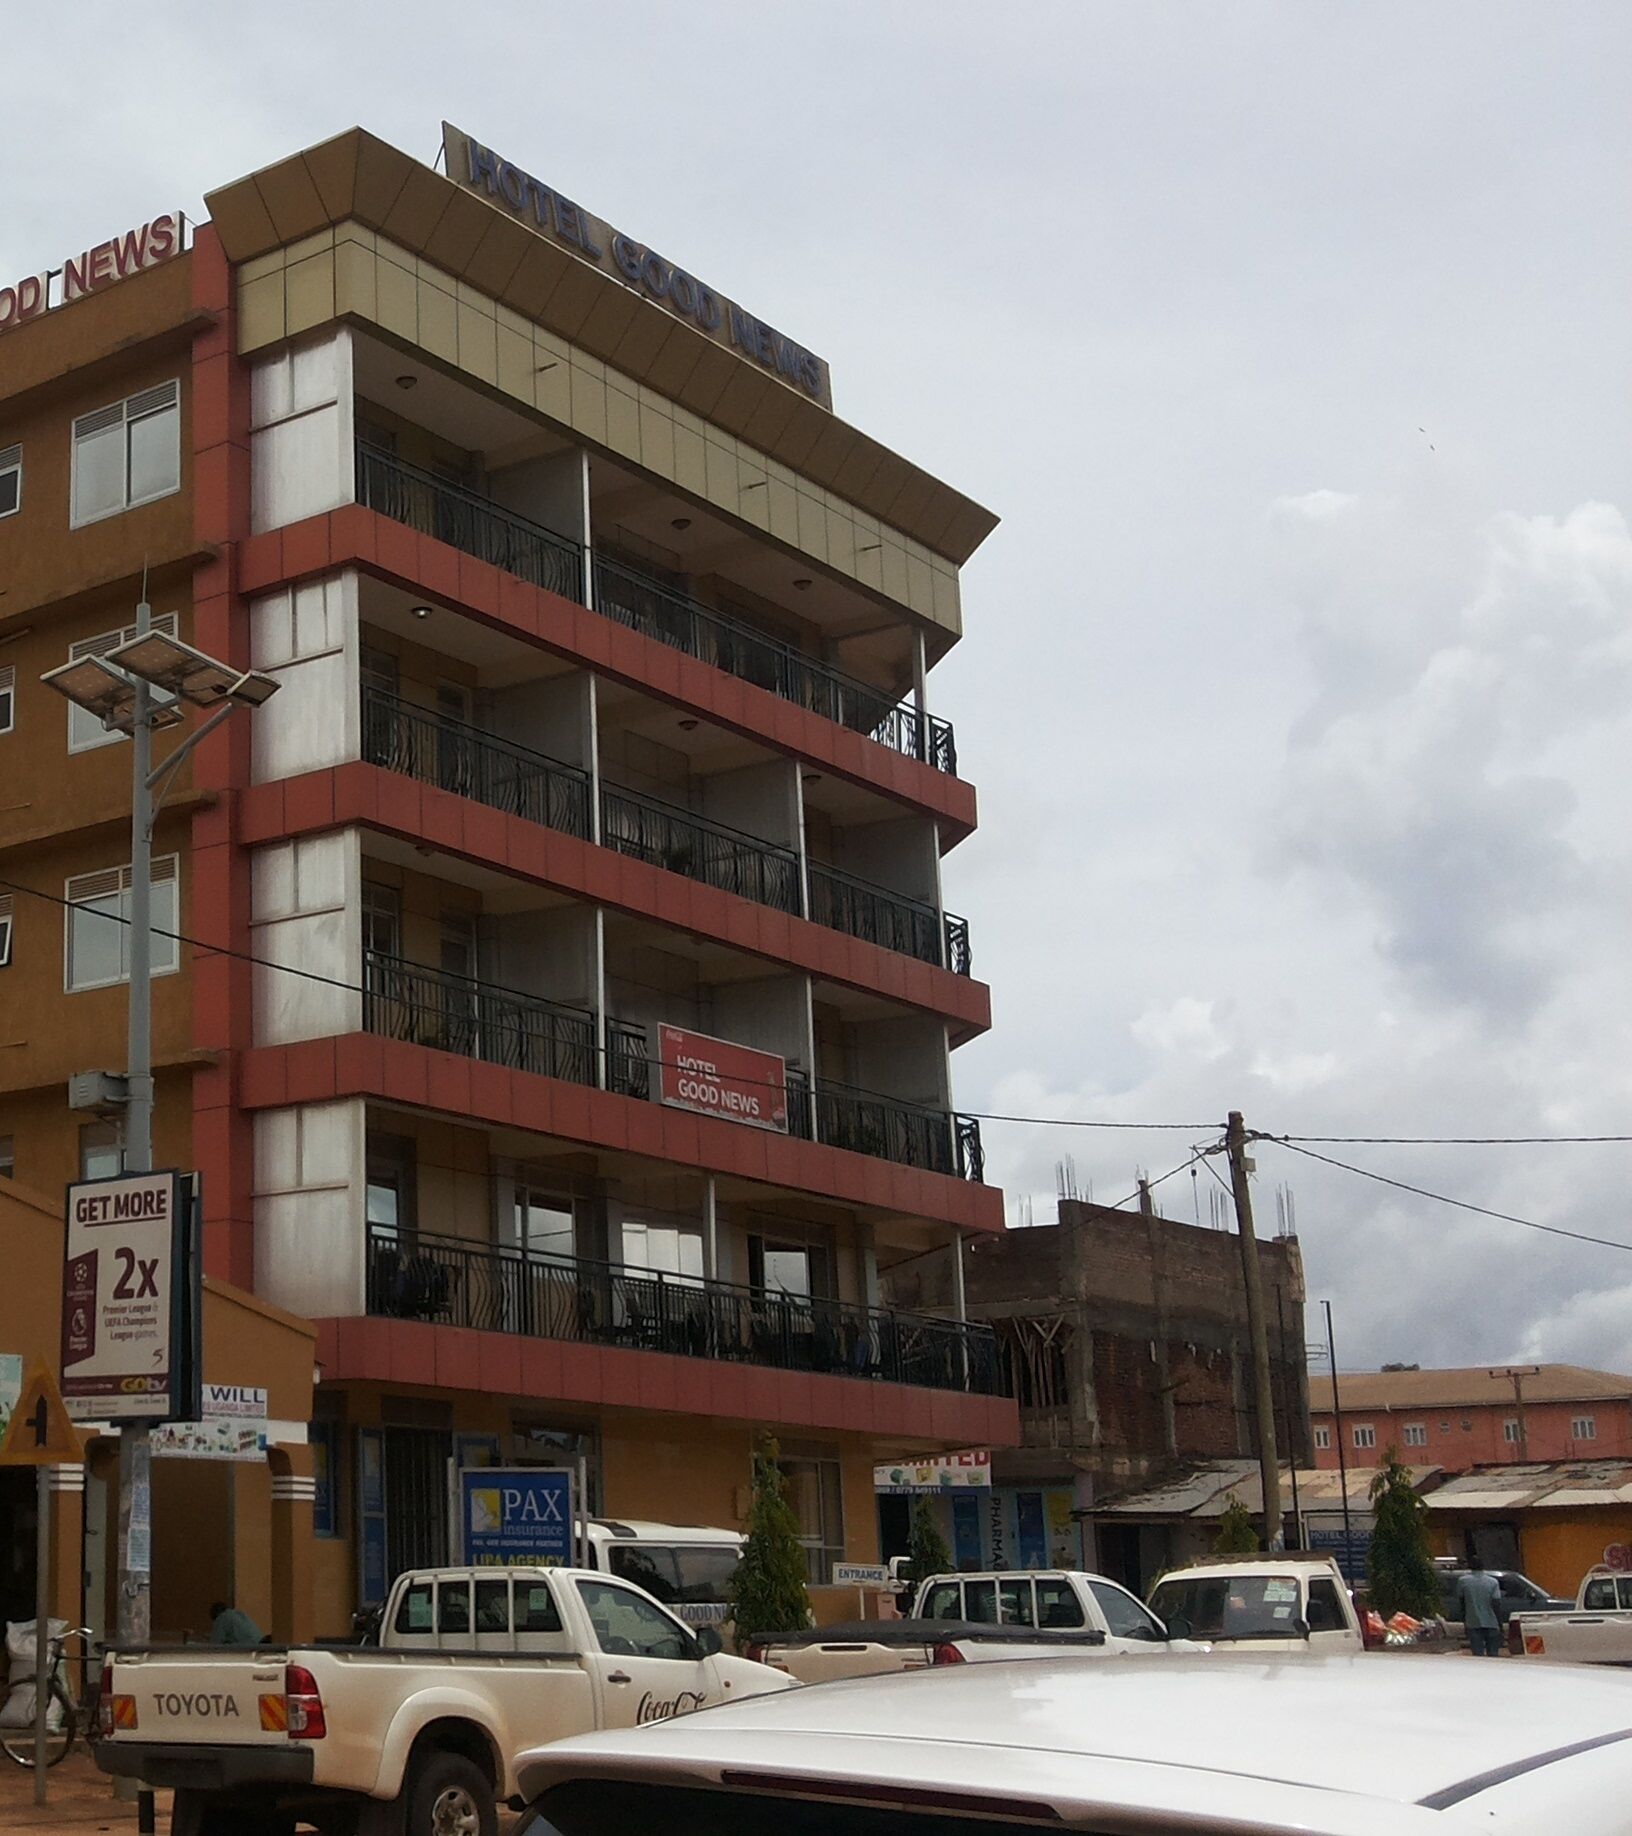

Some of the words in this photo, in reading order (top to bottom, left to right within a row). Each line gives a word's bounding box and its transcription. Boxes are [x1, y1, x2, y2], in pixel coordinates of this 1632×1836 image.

[62, 214, 174, 299] NEWS
[467, 138, 603, 261] HOTEL
[611, 233, 722, 332] GOOD
[729, 304, 822, 397] NEWS
[677, 1054, 720, 1083] HOTEL
[678, 1078, 718, 1105] GOOD
[721, 1089, 760, 1115] NEWS
[76, 1195, 111, 1223] GET
[114, 1189, 167, 1219] MORE
[113, 1246, 159, 1299] 2x
[210, 1386, 265, 1404] WILL
[502, 1488, 563, 1522] PAX
[503, 1525, 564, 1536] insurance
[508, 1553, 565, 1568] AGENCY
[838, 1567, 884, 1581] ENTRANCE
[680, 1604, 712, 1621] GOOD
[153, 1693, 240, 1717] TOYOTA
